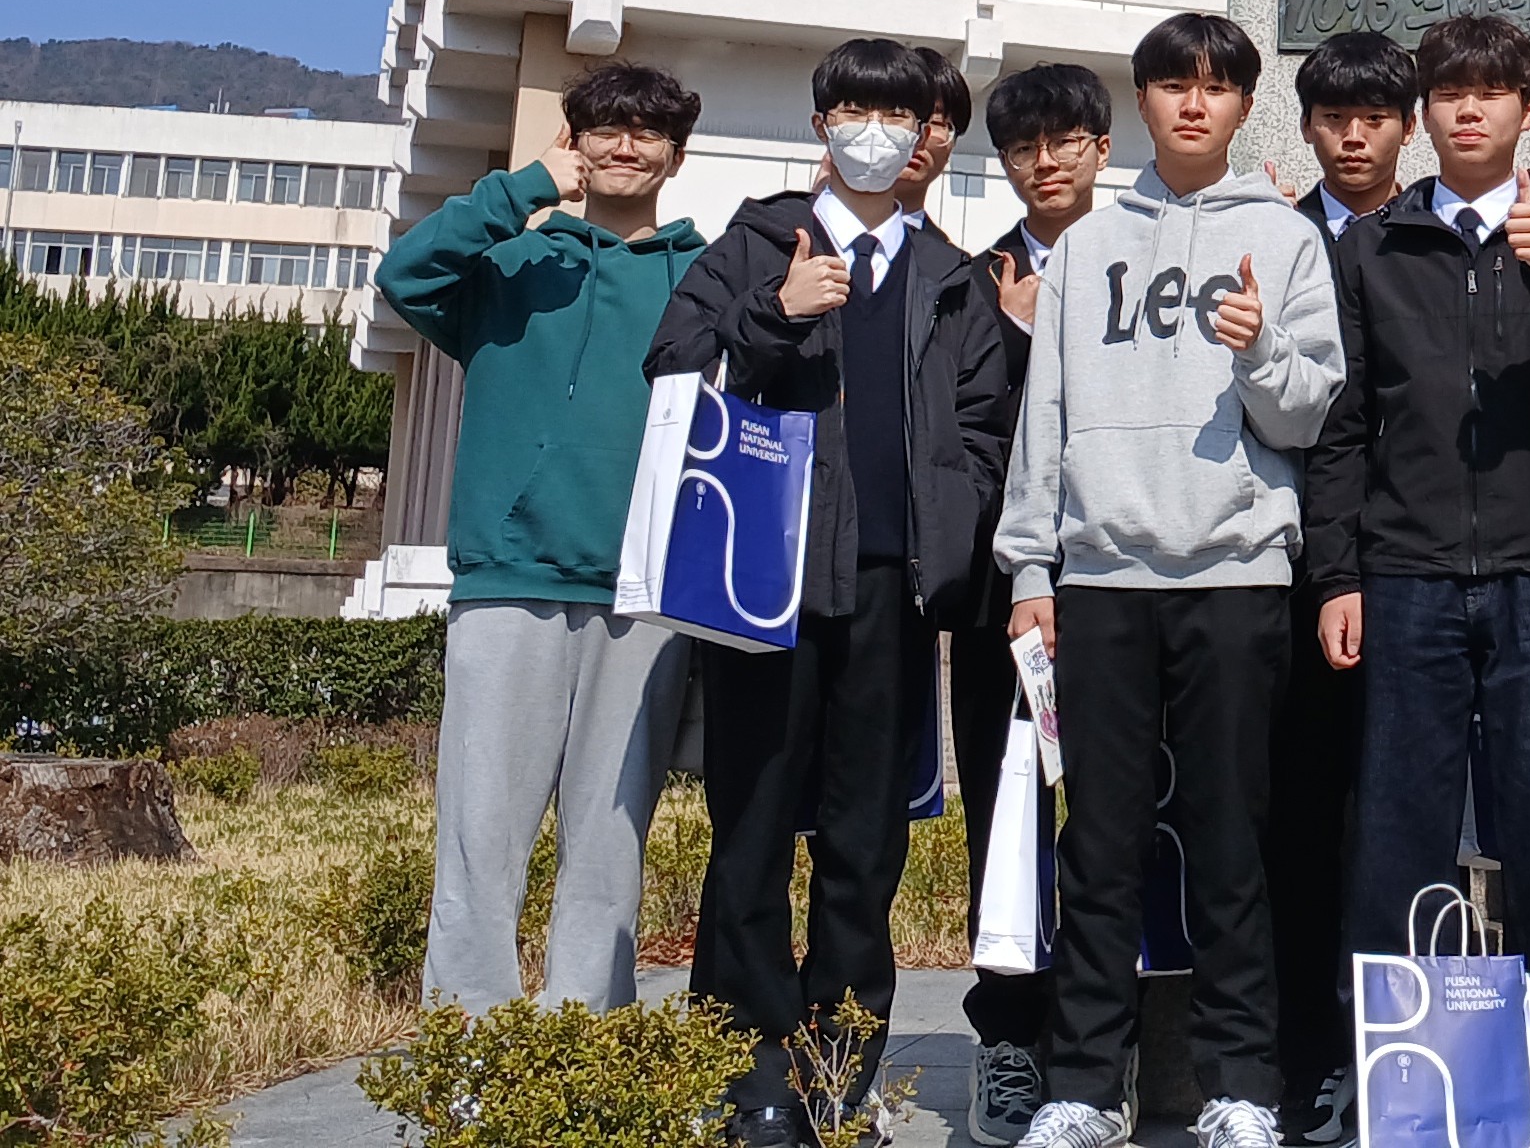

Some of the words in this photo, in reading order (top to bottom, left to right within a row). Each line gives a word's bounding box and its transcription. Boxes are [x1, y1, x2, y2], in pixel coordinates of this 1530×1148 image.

[1102, 261, 1243, 345] Lee
[741, 419, 770, 436] PUSAN
[740, 432, 785, 452] NATIONAL
[739, 442, 790, 464] UNIVERSITY
[1445, 975, 1480, 987] PUSAN
[1445, 988, 1500, 999] NATIONAL
[1446, 998, 1507, 1011] UNIVERSITY
